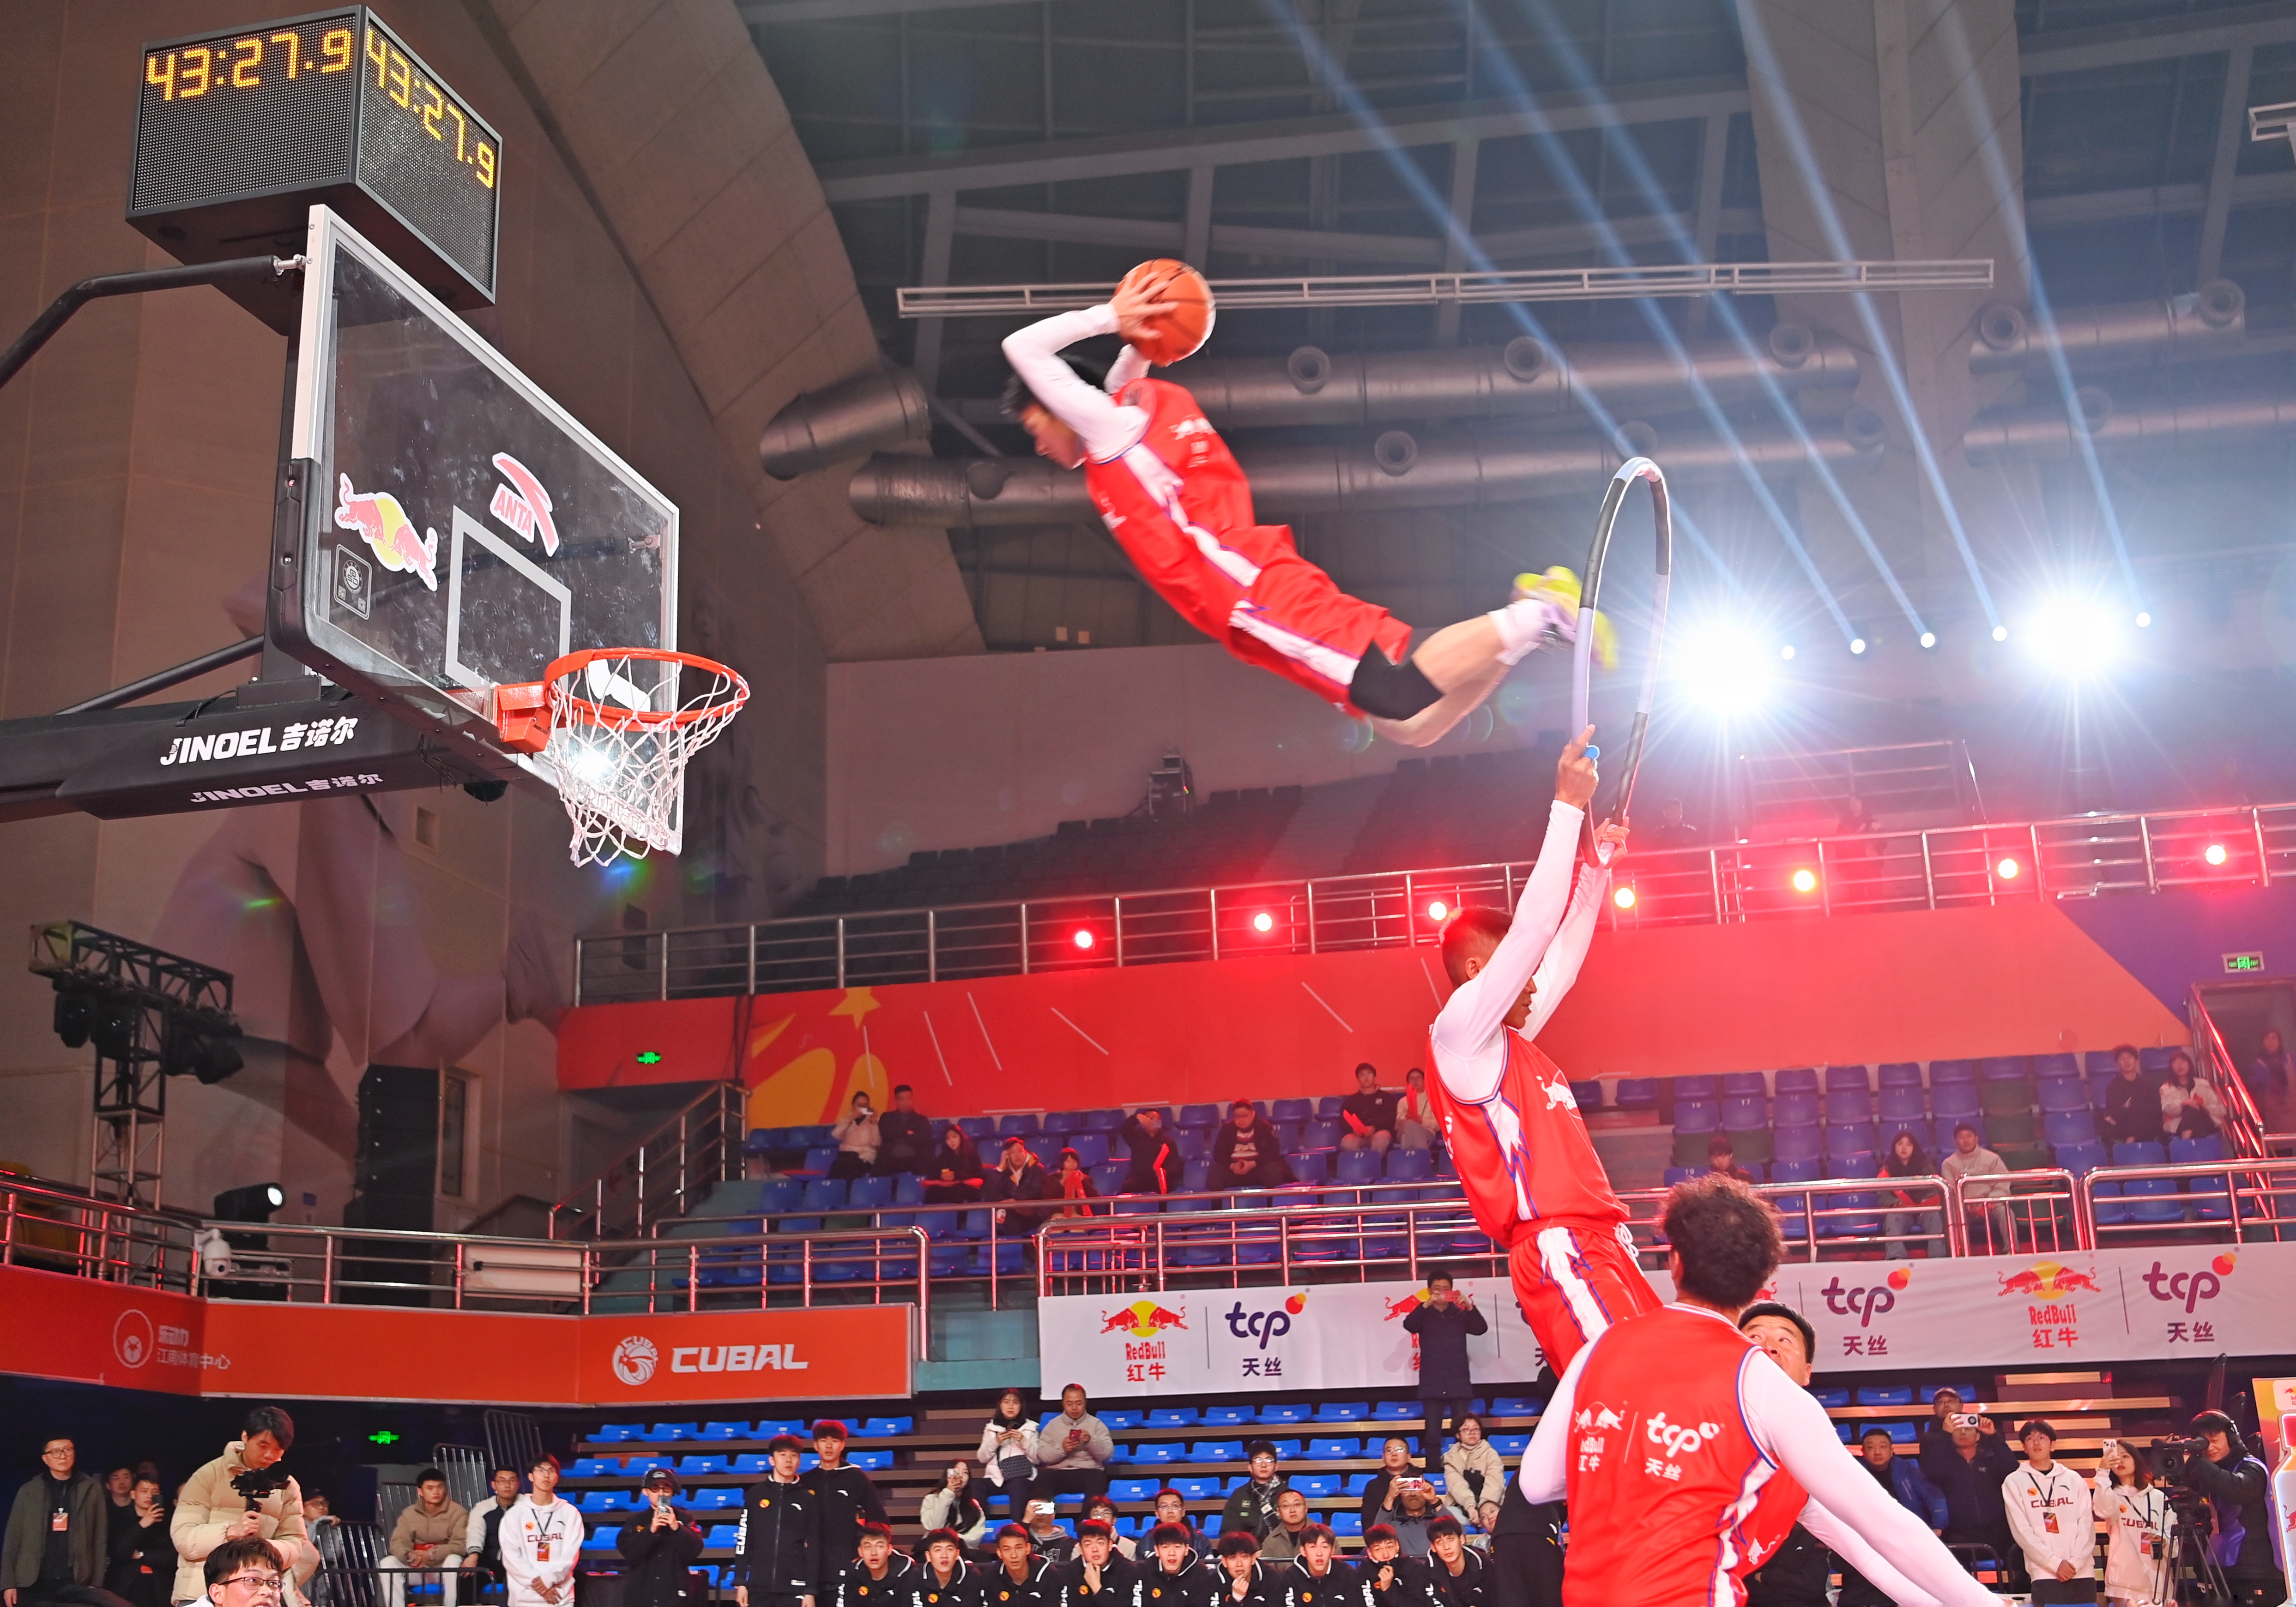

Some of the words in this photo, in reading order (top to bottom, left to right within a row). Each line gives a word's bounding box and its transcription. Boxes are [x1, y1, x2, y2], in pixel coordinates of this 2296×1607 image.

[145, 30, 351, 101] 43:27.9
[366, 26, 495, 188] 43:27.9
[494, 489, 532, 536] ANTA
[160, 727, 277, 766] JINOEL
[280, 716, 358, 752] 吉诺尔
[190, 782, 308, 803] JINOEL
[305, 773, 384, 791] 吉诺尔
[1821, 1276, 1894, 1327] tcp
[2142, 1261, 2220, 1314] tcp
[1225, 1301, 1290, 1350] tcp
[2028, 1304, 2077, 1325] RedBull
[1843, 1335, 1888, 1356] 天丝
[2033, 1328, 2079, 1348] 红牛
[2167, 1322, 2215, 1343] 天丝
[671, 1343, 809, 1373] CUBAL
[1125, 1341, 1166, 1360] RedBull
[1127, 1362, 1166, 1382] 红牛
[1242, 1357, 1282, 1377] 天丝
[1580, 1437, 1605, 1454] edBull
[1646, 1412, 1701, 1458] tcp
[1644, 1457, 1682, 1481] 天丝
[2030, 1497, 2074, 1508] CUBAL
[736, 1509, 748, 1555] CUBAL
